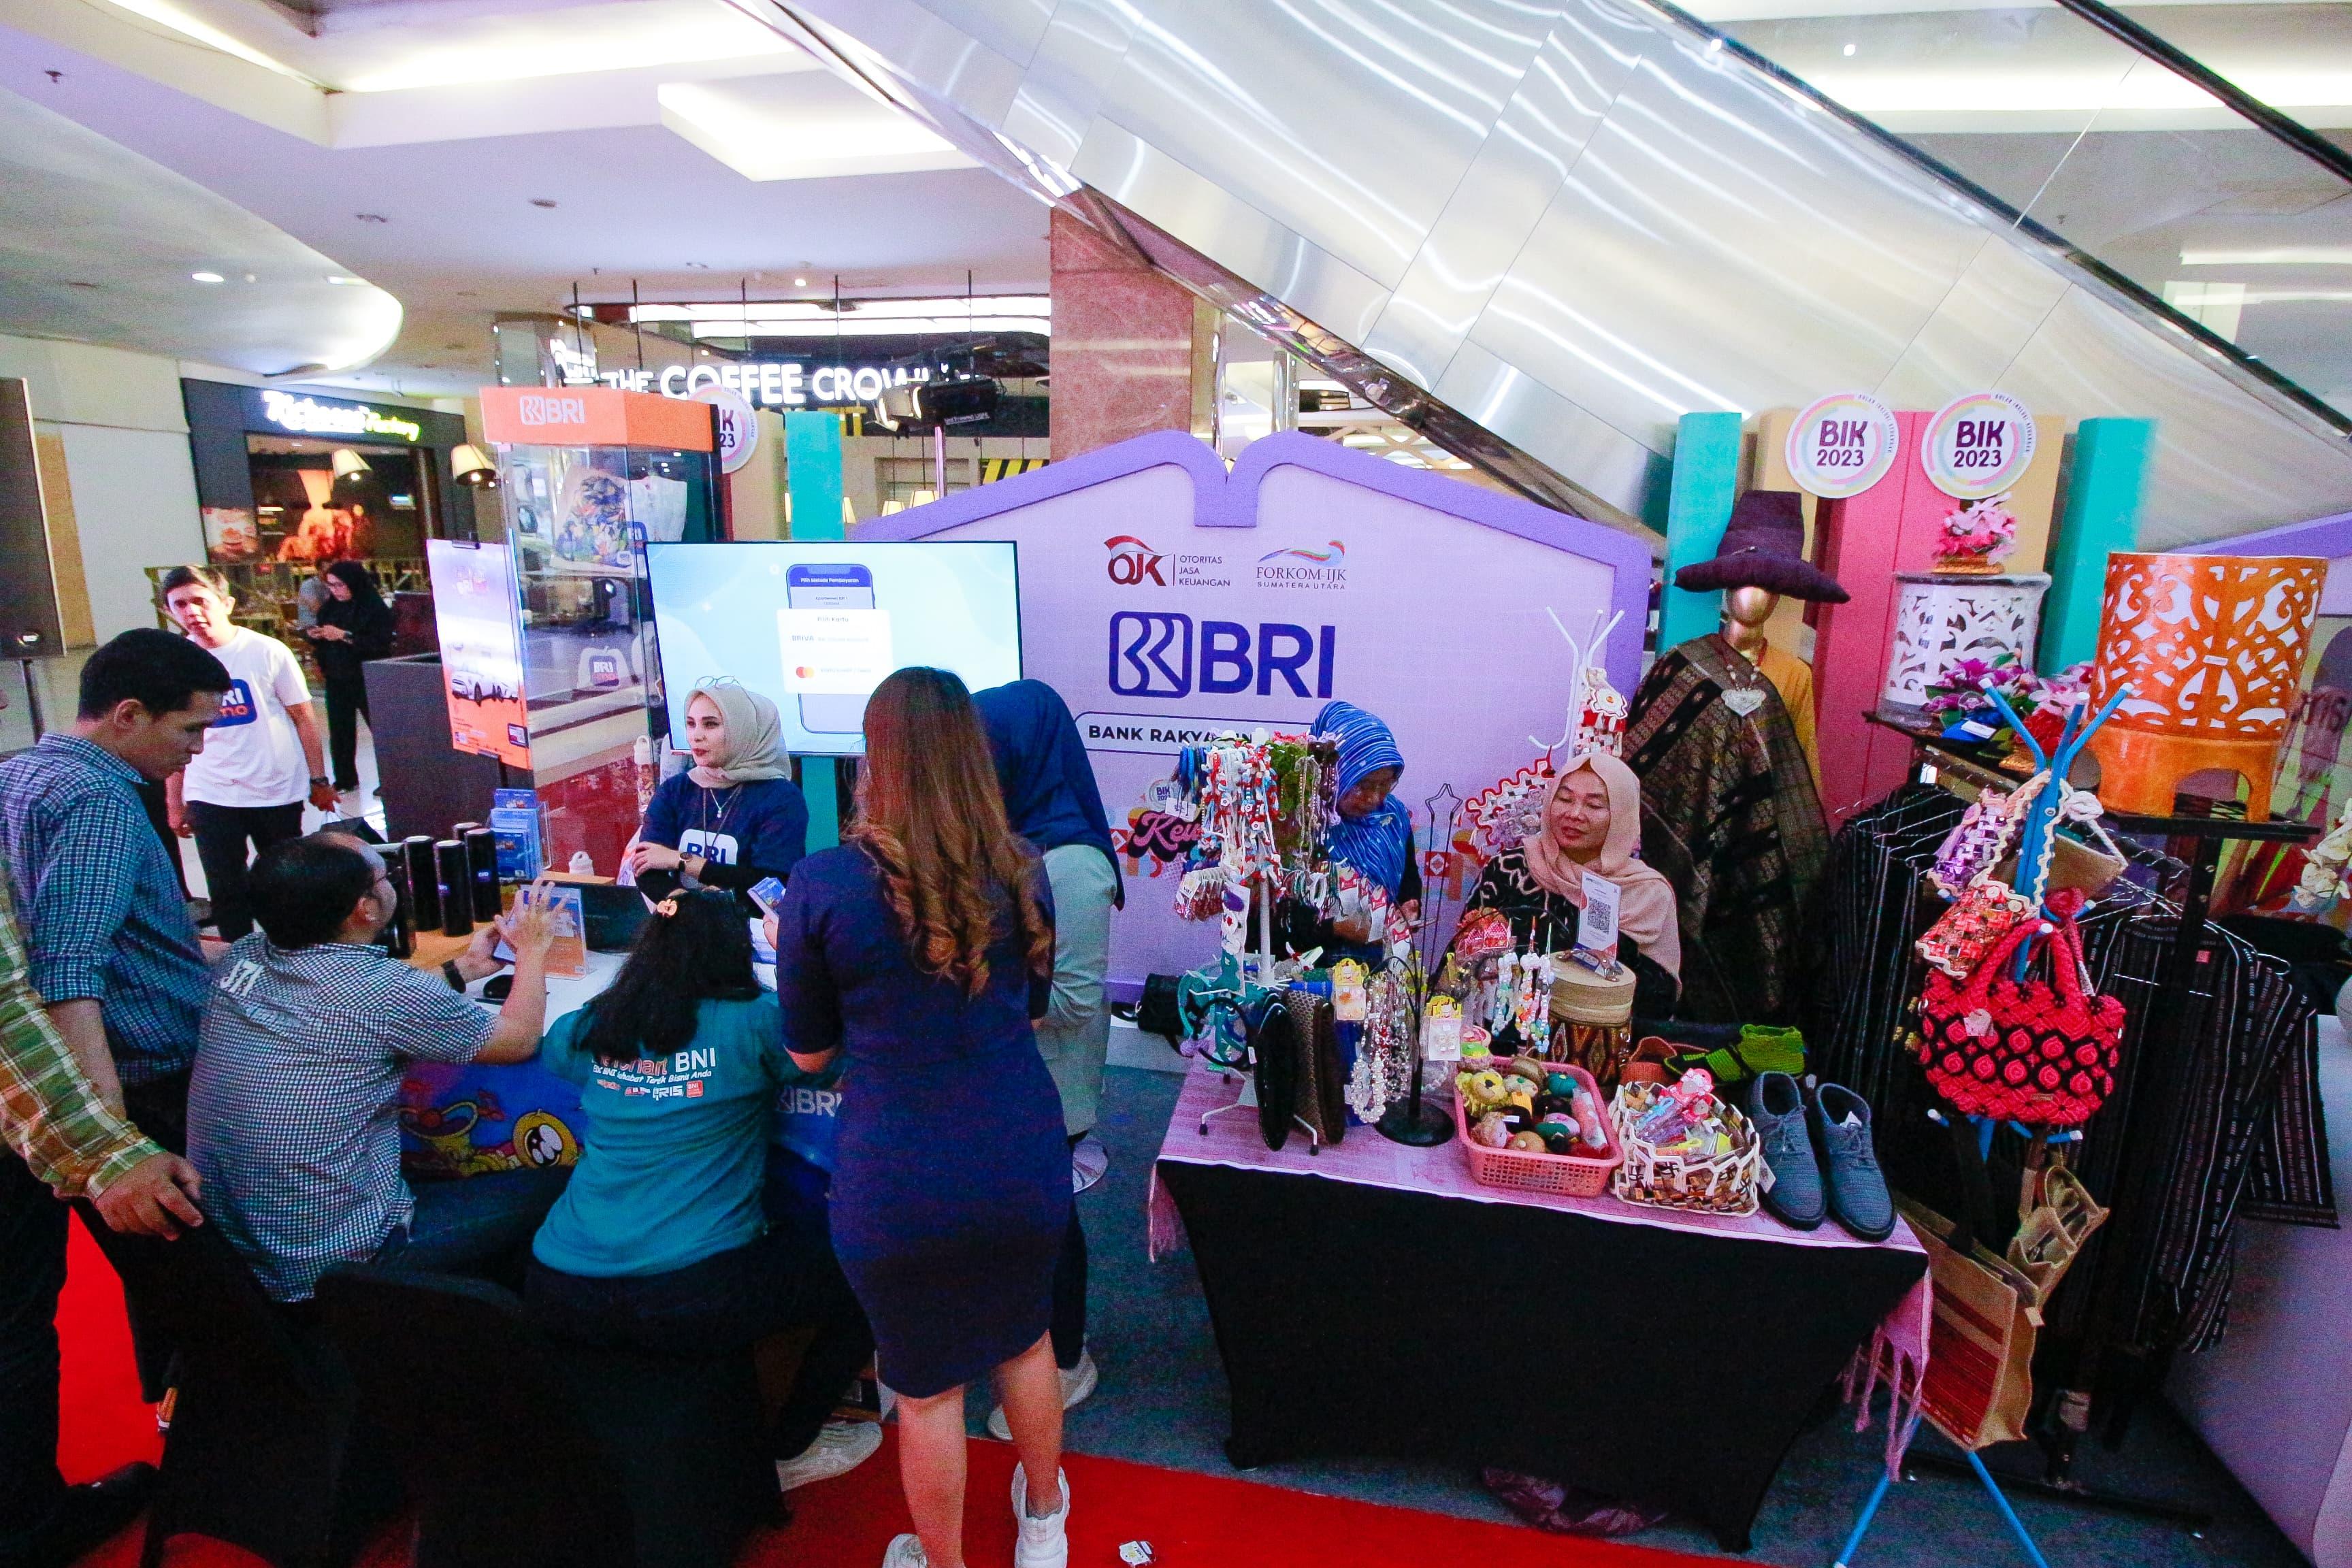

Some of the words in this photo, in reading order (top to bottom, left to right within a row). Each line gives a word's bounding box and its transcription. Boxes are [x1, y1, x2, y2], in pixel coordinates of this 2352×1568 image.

[600, 368, 653, 393] THE
[659, 362, 806, 404] COFFEE
[546, 397, 585, 424] BRI
[1819, 420, 1868, 447] BIK
[1956, 421, 2005, 448] BIK
[1816, 448, 1864, 467] 2023
[1954, 449, 2002, 468] 2023
[1179, 555, 1223, 564] OTORITAS
[1179, 567, 1200, 575] JASA
[1256, 567, 1348, 584] FORKOM-IJK
[1179, 578, 1231, 587] KEUANGAN
[1199, 620, 1336, 700] BRI
[222, 687, 246, 707] RI
[1088, 725, 1144, 741] BANK
[1156, 787, 1171, 796] BIK
[686, 842, 727, 865] BRI
[675, 1047, 717, 1073] BNI
[690, 1069, 712, 1079] Anda
